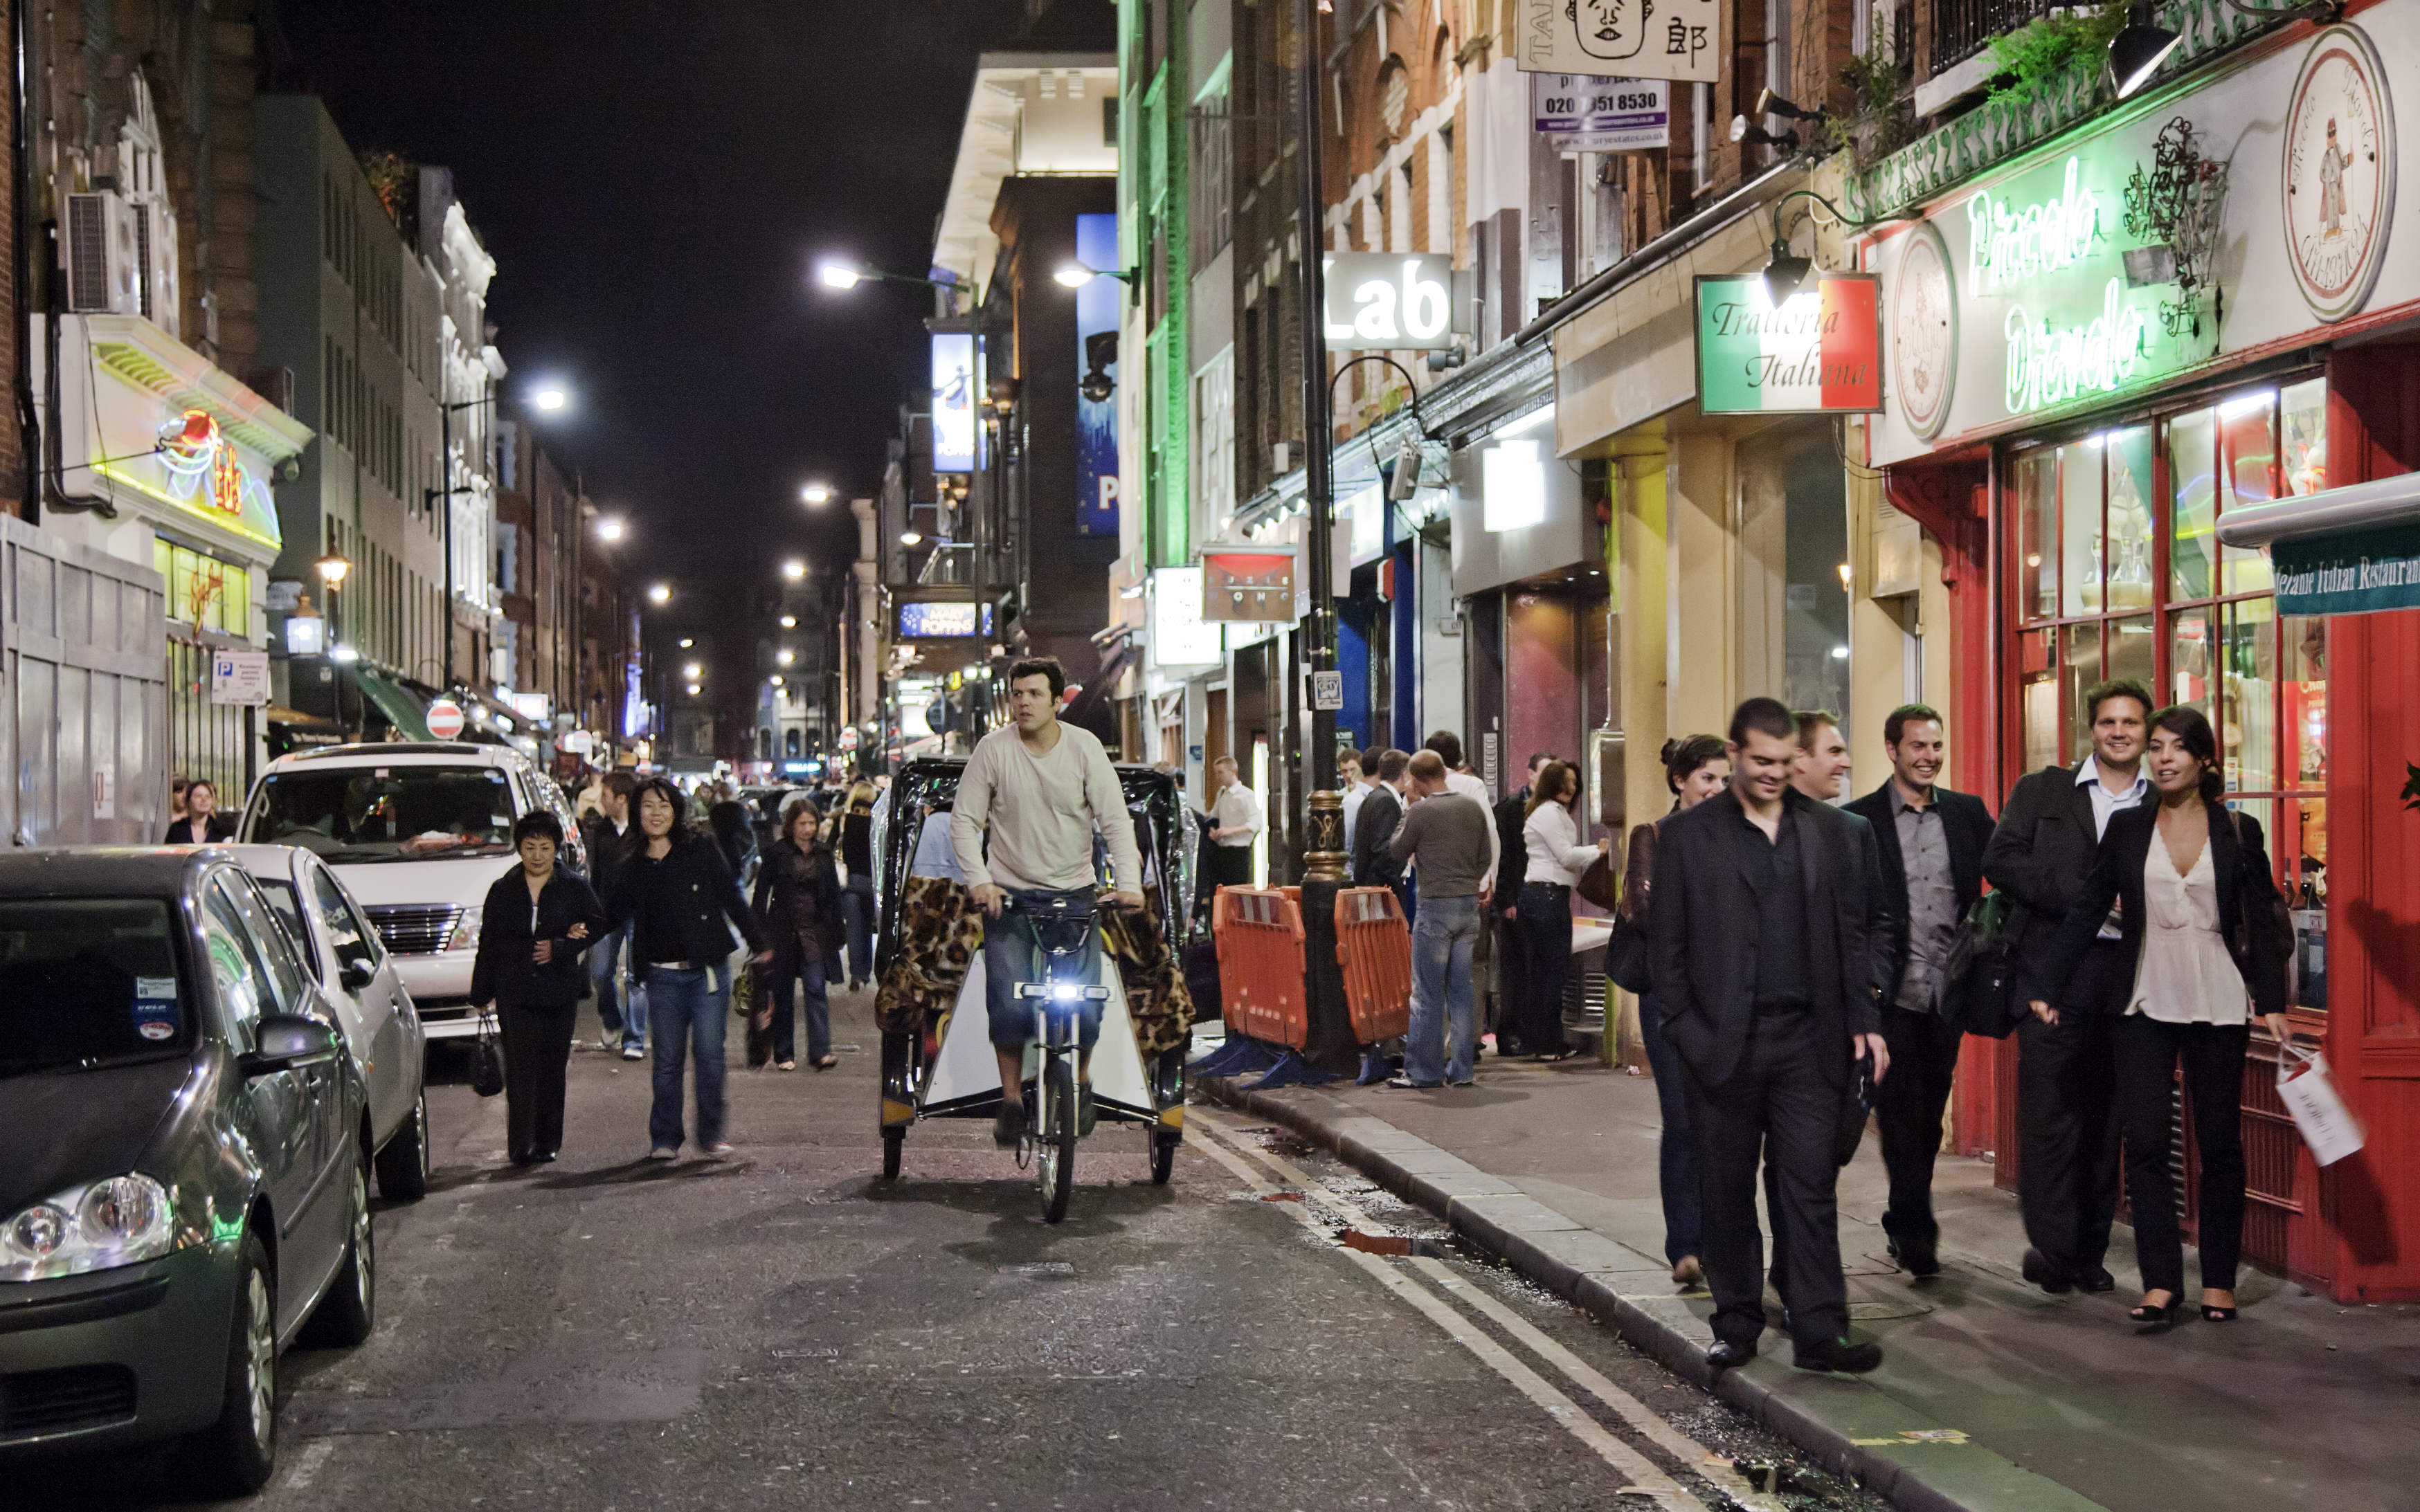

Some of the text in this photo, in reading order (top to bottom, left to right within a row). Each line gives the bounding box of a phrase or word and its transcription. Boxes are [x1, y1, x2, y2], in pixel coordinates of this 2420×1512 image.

[1528, 0, 1554, 64] TA
[1665, 0, 1712, 69] 郎
[1546, 97, 1575, 113] 020
[1618, 92, 1657, 110] 8530
[1967, 156, 2100, 300] Piccolo
[1322, 259, 1450, 340] Lab
[1712, 298, 1841, 336] Trattoria
[1745, 340, 1868, 388] Italiana
[2004, 276, 2144, 414] Diavolo
[1098, 475, 1119, 510] P
[2317, 559, 2355, 594] Italian
[2358, 556, 2420, 590] Restauran
[921, 618, 975, 635] POPPINS
[929, 608, 965, 621] MARY
